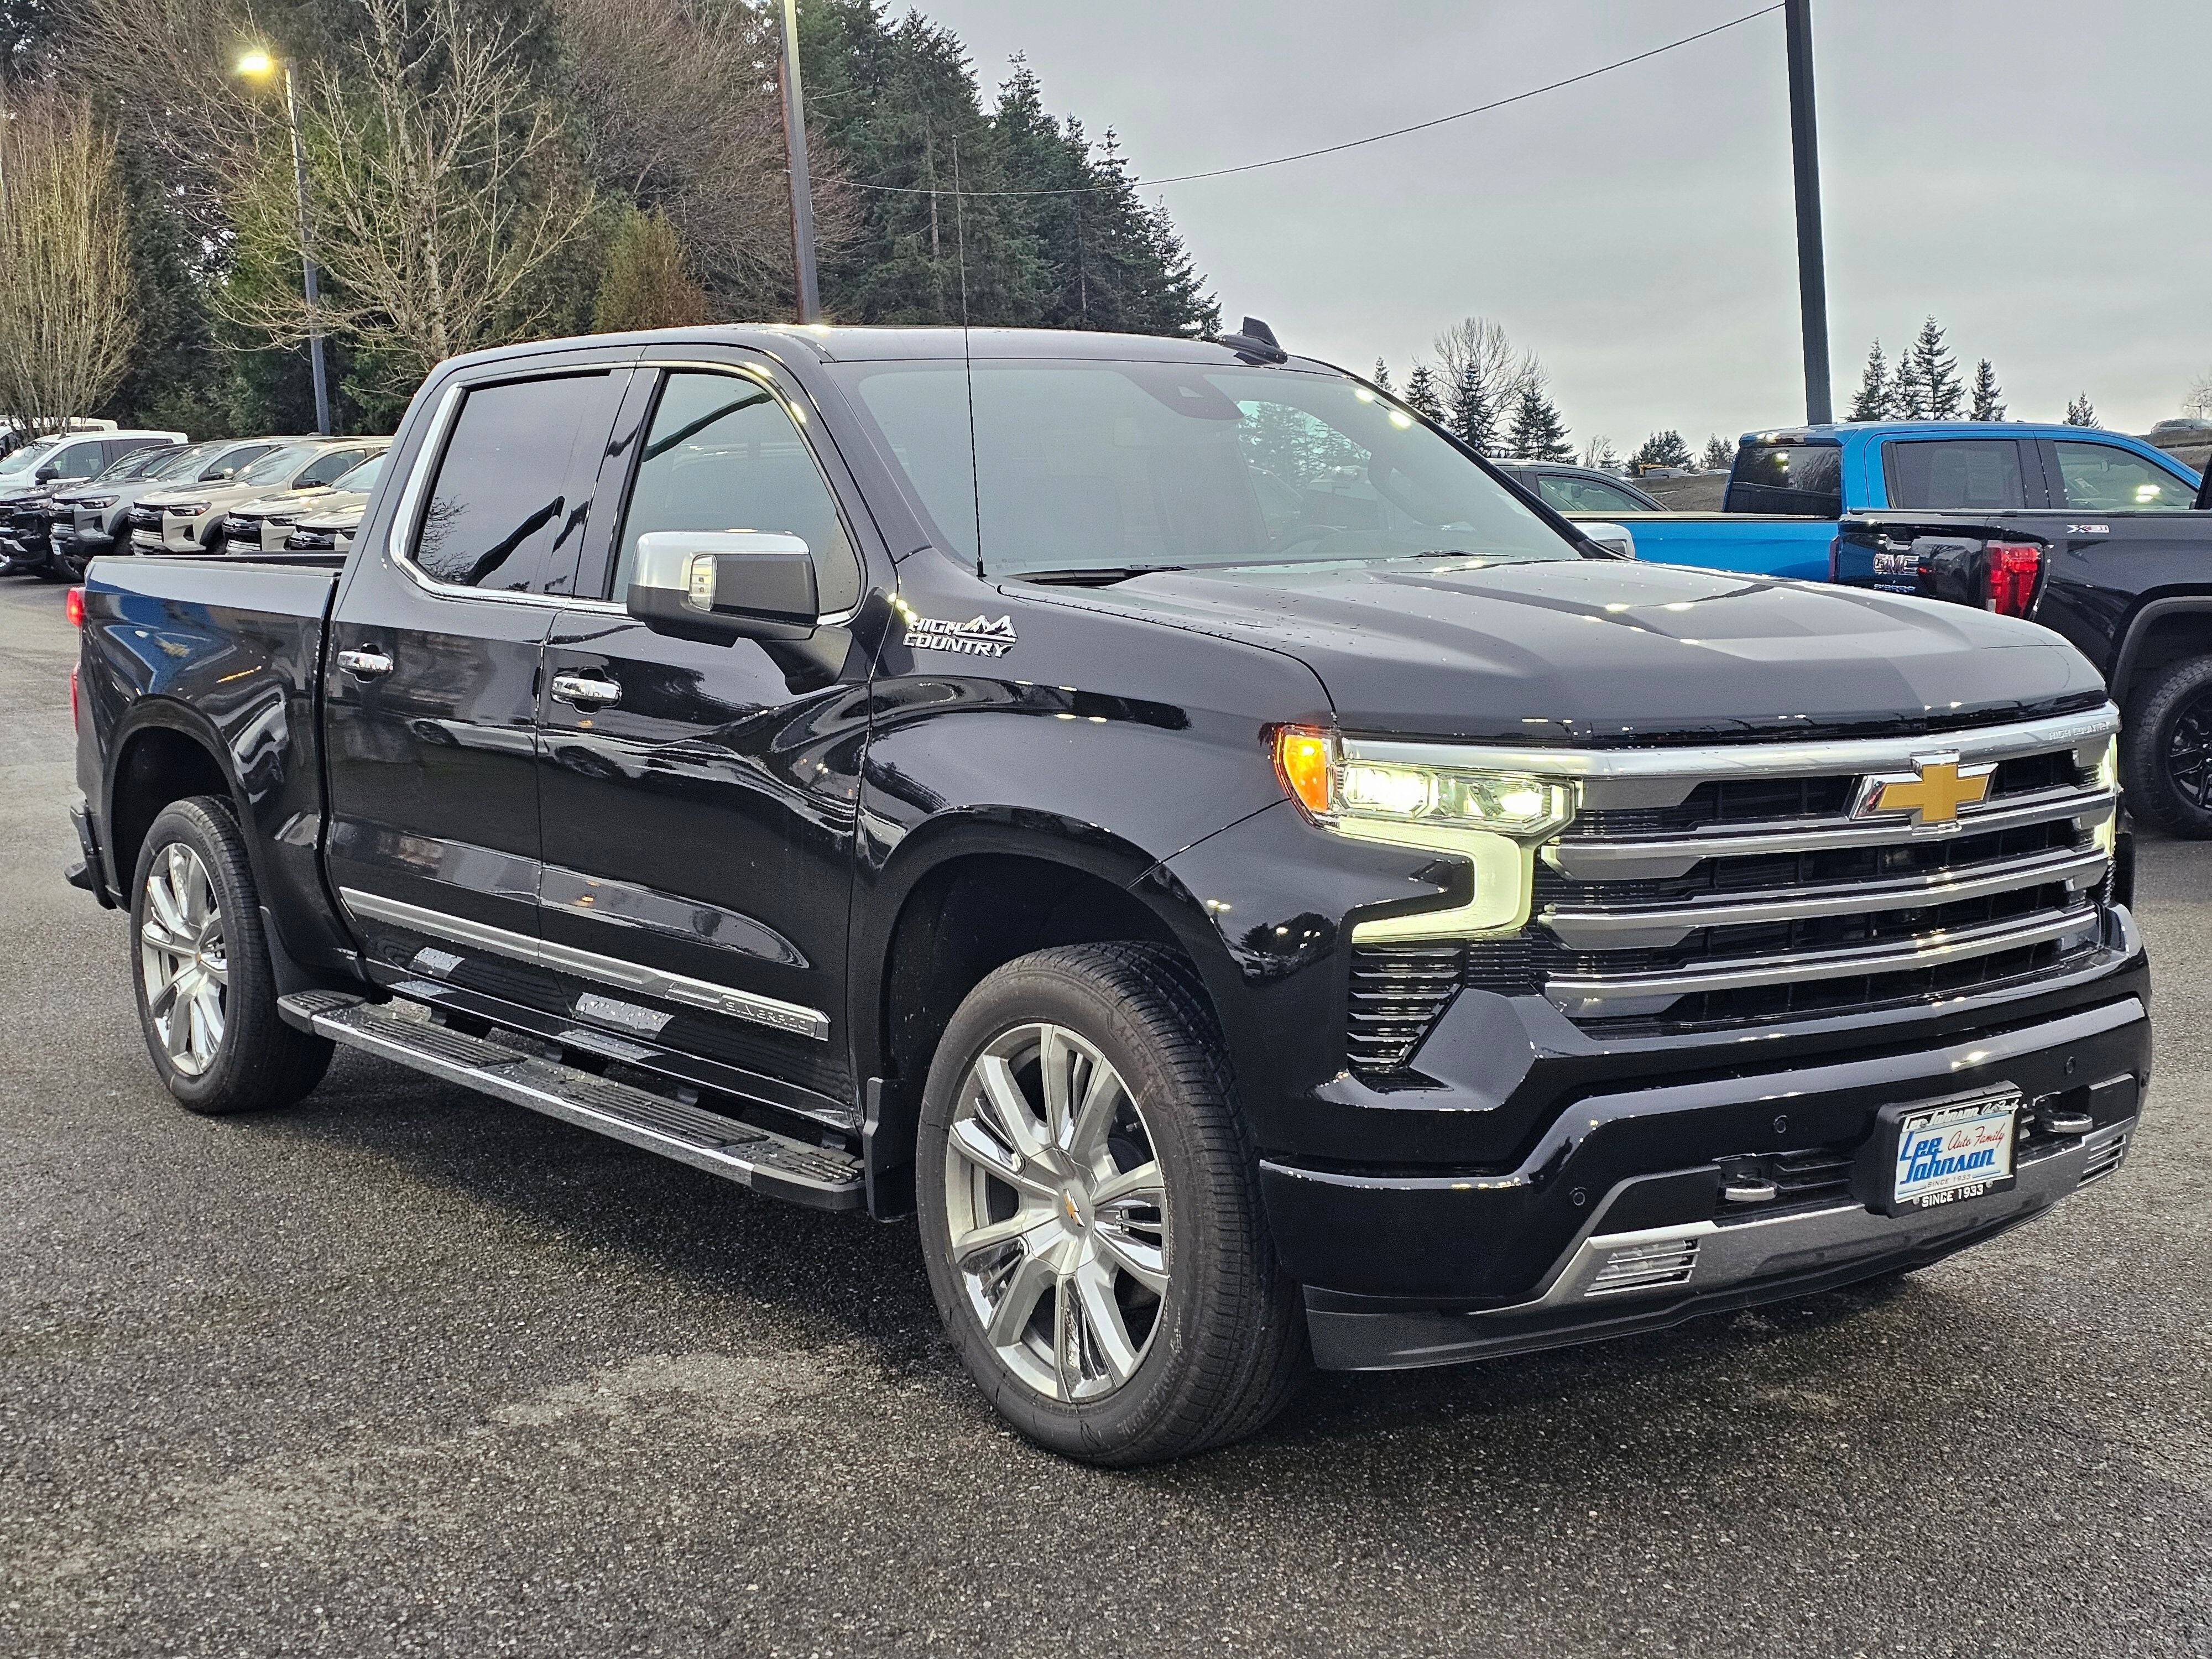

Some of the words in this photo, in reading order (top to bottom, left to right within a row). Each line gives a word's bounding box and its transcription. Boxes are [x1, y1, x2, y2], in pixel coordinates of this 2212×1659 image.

[1873, 554, 1919, 576] GMC
[907, 618, 965, 635] HIGH
[903, 633, 1013, 658] COUNTRY
[2048, 729, 2072, 740] HIGH
[2073, 721, 2110, 735] COUNTRY
[1900, 1131, 1943, 1161] Lee
[1948, 1130, 1971, 1151] Auto
[1975, 1123, 2005, 1148] Family
[1900, 1147, 1996, 1185] Johnson
[1927, 1178, 1949, 1188] SINCE
[1953, 1174, 1971, 1184] 1933
[1922, 1190, 1954, 1208] SINCE
[1958, 1184, 1984, 1199] 1933
